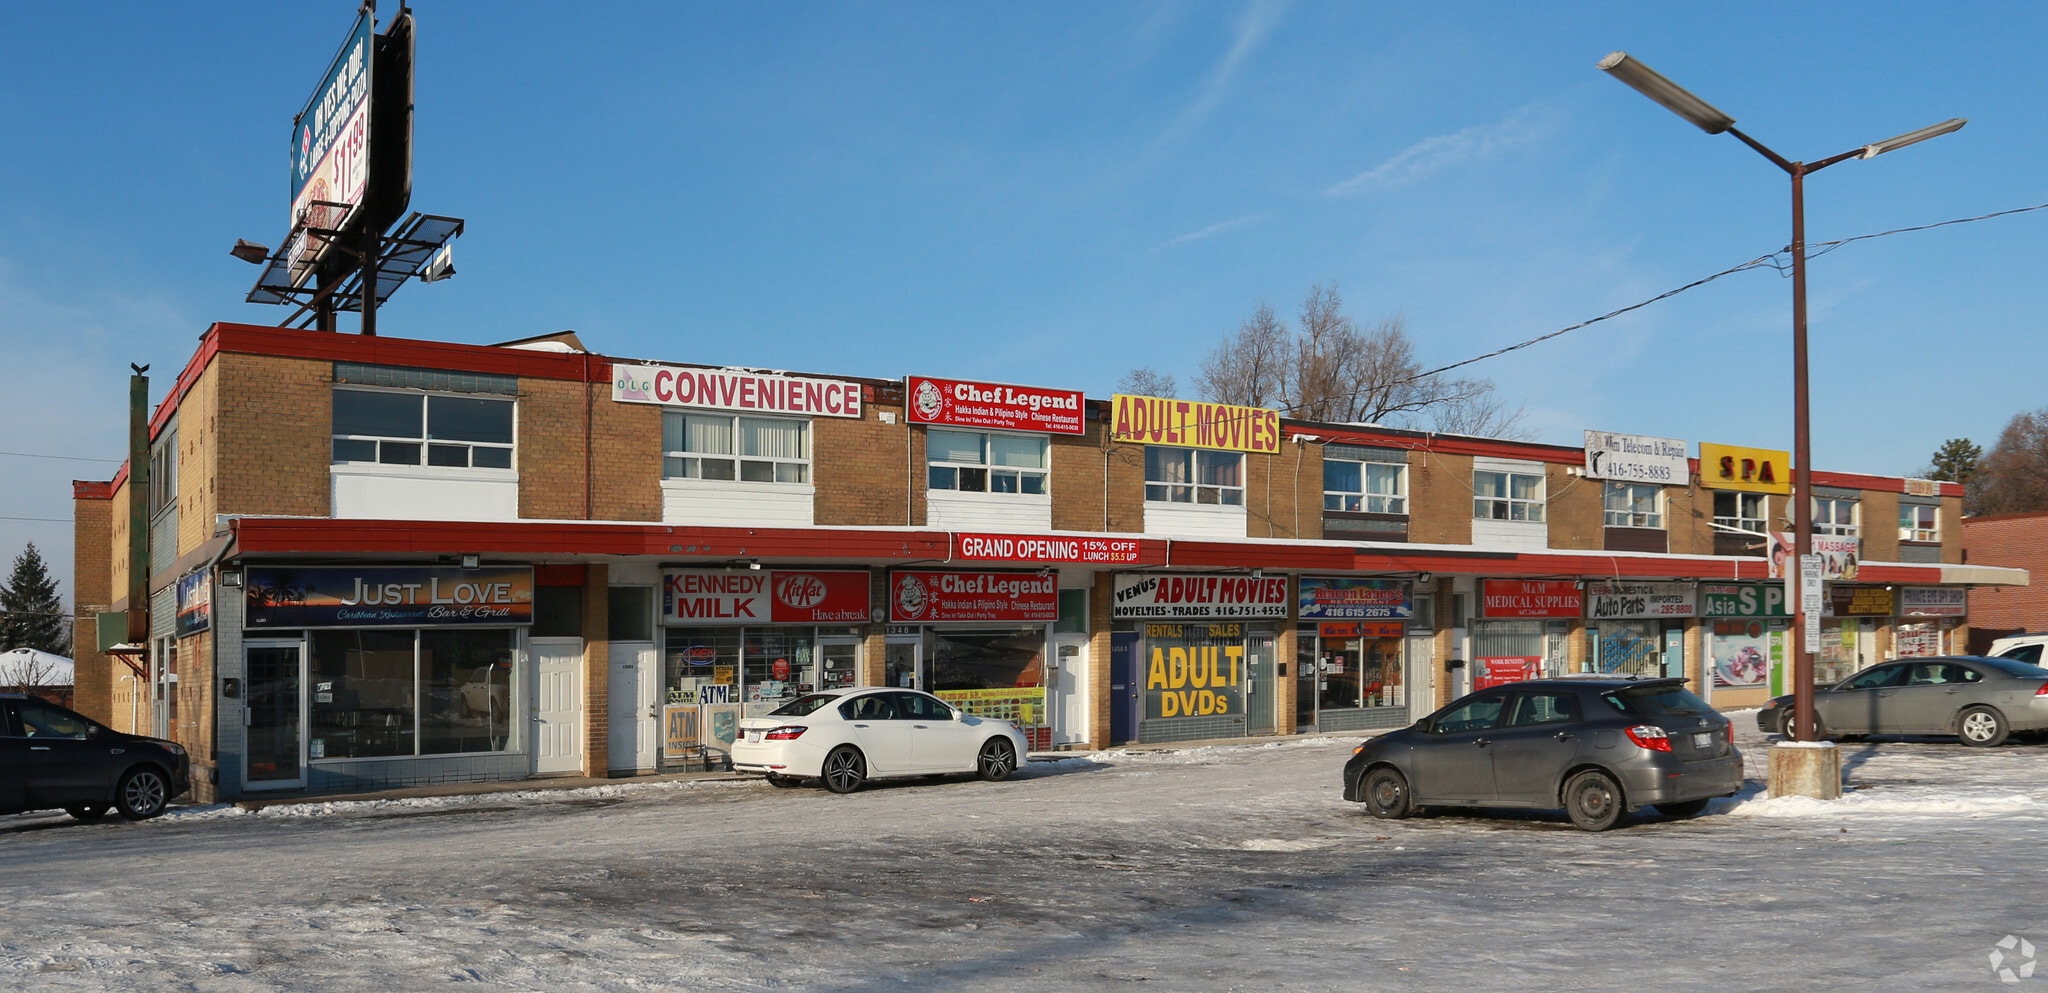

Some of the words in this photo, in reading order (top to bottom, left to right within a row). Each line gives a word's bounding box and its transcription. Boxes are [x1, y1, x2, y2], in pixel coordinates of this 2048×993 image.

[314, 102, 324, 138] OH
[324, 82, 336, 124] YES
[336, 62, 348, 104] WE
[348, 36, 363, 86] DID!
[351, 68, 366, 112] PIZZA
[654, 370, 858, 415] CONVENIENCE
[954, 383, 1003, 403] Chef
[1006, 388, 1077, 411] Legend
[955, 405, 971, 414] Hakka
[972, 407, 988, 416] Indian
[990, 408, 994, 416] &
[1015, 409, 1028, 420] Style
[1031, 412, 1051, 422] Chinese
[1052, 414, 1078, 424] Restaurant
[1116, 396, 1189, 443] ADULT
[1196, 404, 1276, 451] MOVIES
[1622, 438, 1652, 454] Telecom
[1654, 441, 1660, 456] &
[1661, 442, 1684, 460] Repair
[1608, 462, 1670, 480] 416-755-8883
[1720, 455, 1774, 482] SPA
[962, 538, 1013, 558] GRAND
[1017, 539, 1078, 559] OPENING
[1082, 541, 1108, 551] 15%
[1110, 541, 1136, 552] OFF
[1819, 541, 1856, 552] MASSAGE
[1083, 552, 1109, 561] LUNCH
[1110, 552, 1125, 562] $5.5
[1126, 553, 1137, 562] UP
[341, 577, 422, 605] JUST
[431, 577, 512, 604] LOVE
[672, 575, 765, 594] KENNEDY
[782, 577, 822, 606] KitKat
[941, 575, 983, 593] Chef
[987, 575, 1054, 598] Legend
[1116, 578, 1156, 603] VENUS
[1154, 577, 1217, 604] ADULT
[1219, 578, 1286, 604] MOVIES
[1614, 586, 1648, 594] DOMESTIC
[678, 598, 756, 618] MILK
[942, 600, 956, 609] Hakka
[957, 600, 972, 609] Indian
[973, 601, 977, 609] &
[997, 601, 1008, 611] Style
[1011, 601, 1029, 610] Chinese
[1030, 602, 1054, 610] Restaurant
[1115, 606, 1166, 616] NOVELTIES
[1172, 607, 1210, 616] TRADES
[1215, 606, 1286, 616] 416-751-4554
[1486, 596, 1533, 608] MEDICAL
[1535, 596, 1579, 608] SUPPLIES
[1594, 596, 1619, 617] Auto
[1621, 596, 1645, 616] Parts
[1706, 597, 1735, 614] Asia
[1738, 587, 1782, 615] SP
[337, 609, 377, 620] Caribbean
[380, 610, 425, 620] Restaurant
[427, 606, 458, 618] Bar
[459, 606, 472, 618] &
[474, 606, 510, 618] Grill
[812, 609, 833, 620] Have
[841, 609, 867, 620] break.
[1325, 608, 1343, 617] 416
[1346, 608, 1364, 617] 615
[1366, 609, 1390, 617] 2675
[1146, 624, 1182, 638] RENTALS
[1209, 624, 1240, 637] SALES
[1147, 646, 1243, 690] ADULT
[699, 686, 727, 704] ATM
[1162, 690, 1228, 717] DVDs
[670, 712, 696, 738] ATM
[669, 741, 696, 749] INSIDE
